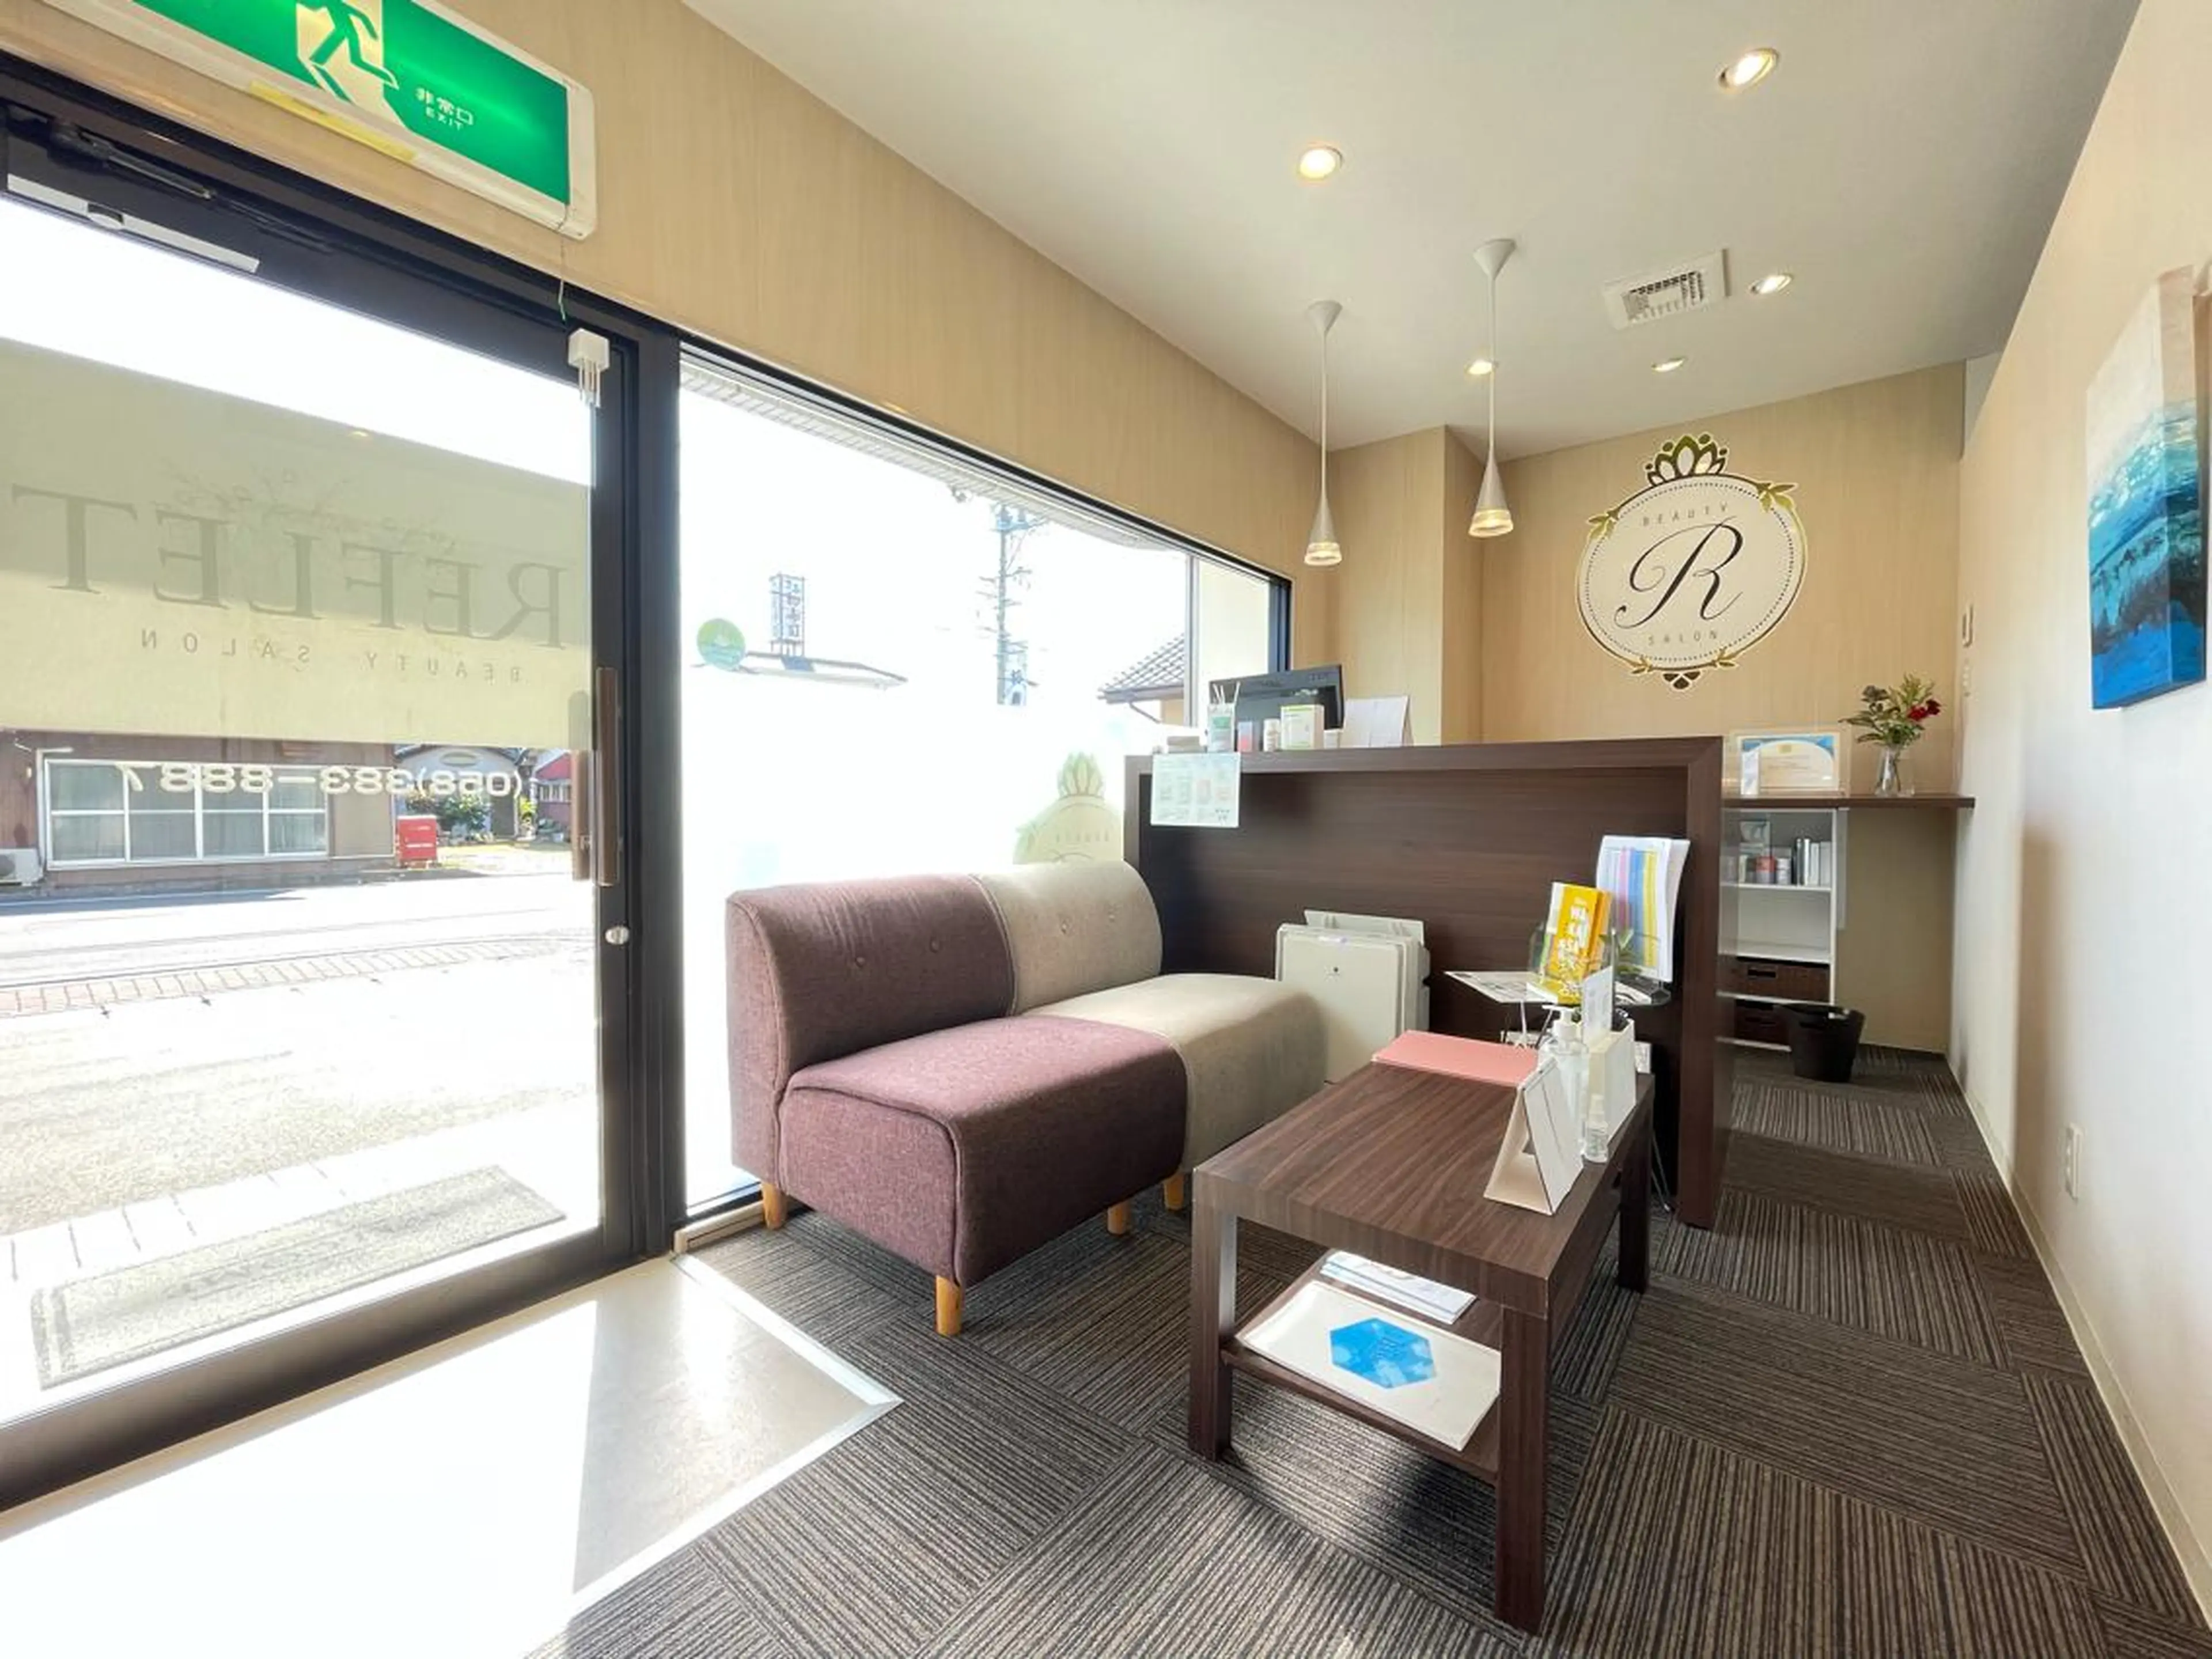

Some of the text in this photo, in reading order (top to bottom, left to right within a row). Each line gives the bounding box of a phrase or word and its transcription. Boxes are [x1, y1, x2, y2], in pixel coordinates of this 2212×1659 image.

[415, 88, 474, 126] 非常口
[426, 106, 463, 130] EXIT
[1643, 502, 1728, 527] BEAUTY
[1613, 515, 1744, 629] R
[1647, 630, 1717, 646] SALON
